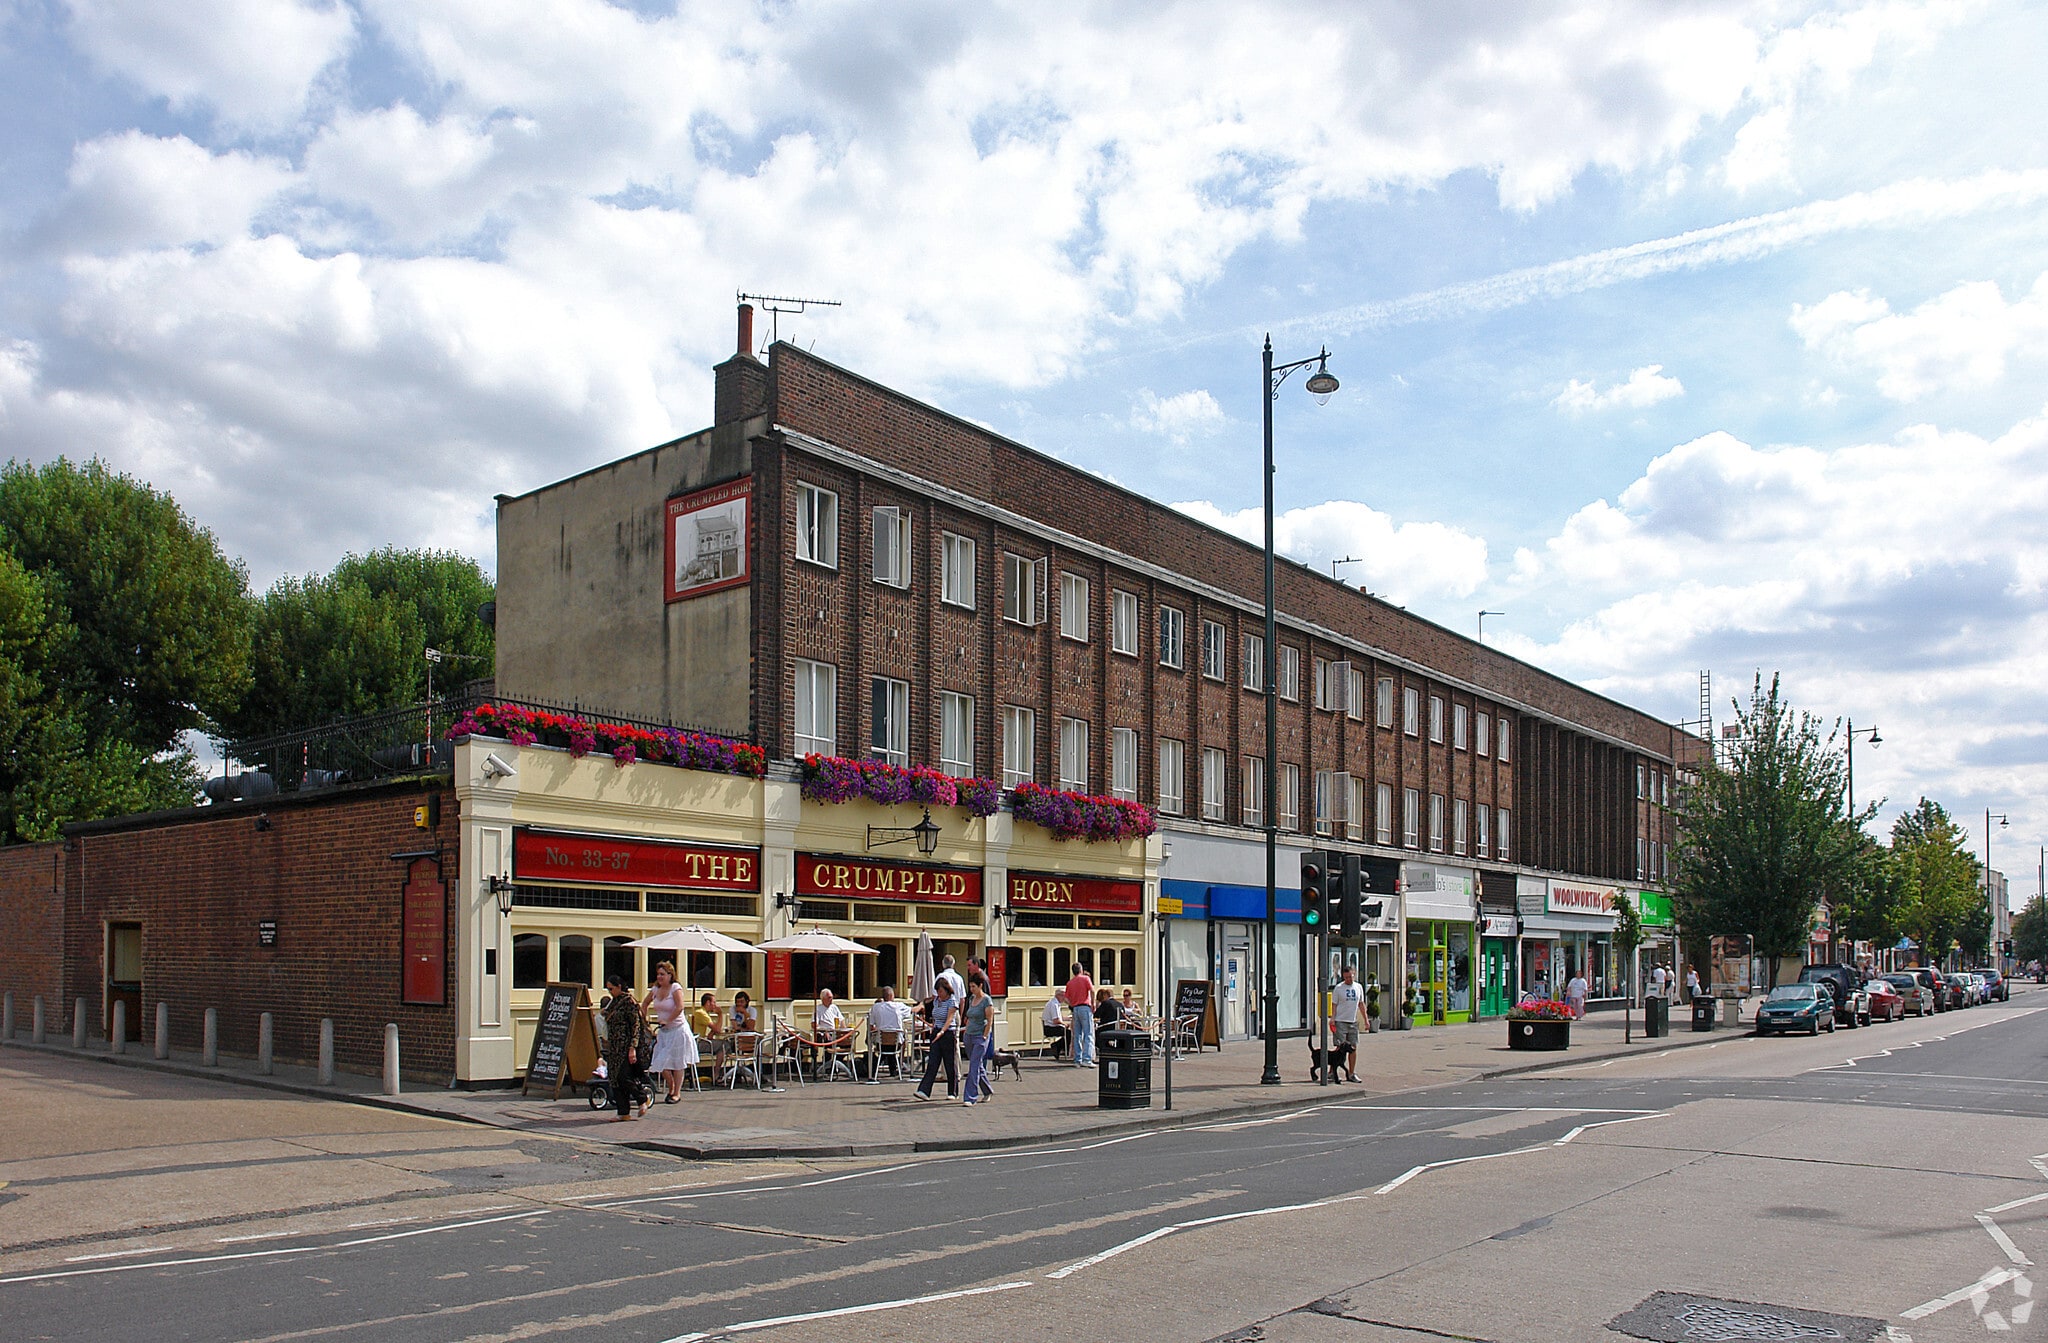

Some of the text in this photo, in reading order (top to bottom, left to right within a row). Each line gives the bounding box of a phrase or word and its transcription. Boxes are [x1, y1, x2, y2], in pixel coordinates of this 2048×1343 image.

[669, 501, 684, 514] THE
[687, 489, 729, 509] CRUMPLED
[545, 847, 631, 870] No. 33-37
[685, 853, 752, 882] THE
[813, 863, 966, 896] CRUMPLED
[1012, 879, 1074, 903] HORN
[1553, 887, 1601, 909] WOOLWORTHS
[1181, 996, 1204, 1005] Delicious
[1183, 987, 1193, 996] Try
[1345, 989, 1356, 998] 29
[548, 1001, 570, 1013] Doubles
